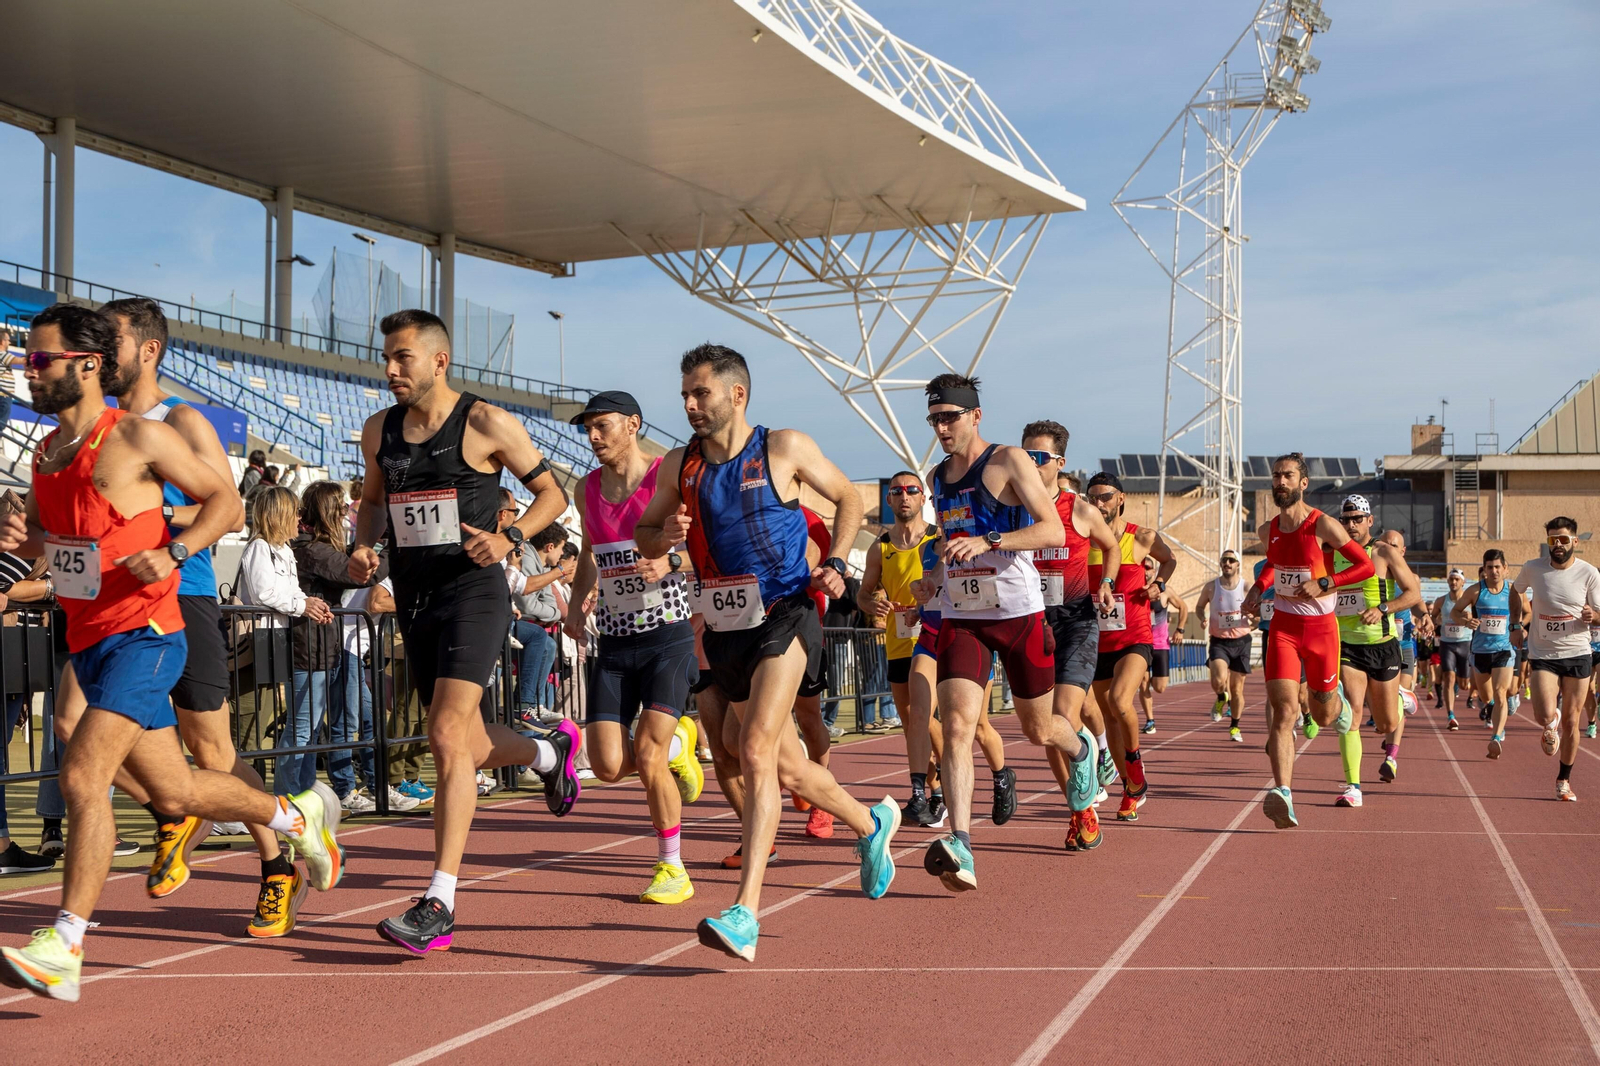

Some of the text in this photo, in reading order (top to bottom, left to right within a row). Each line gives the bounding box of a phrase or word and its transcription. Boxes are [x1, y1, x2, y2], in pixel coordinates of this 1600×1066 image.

[404, 504, 440, 526] 511
[53, 549, 85, 574] 425
[613, 576, 646, 596] 353
[961, 579, 980, 595] 18
[1280, 573, 1301, 585] 571
[713, 589, 747, 611] 645
[1338, 595, 1357, 606] 278
[1486, 619, 1501, 627] 537
[1546, 621, 1566, 632] 621
